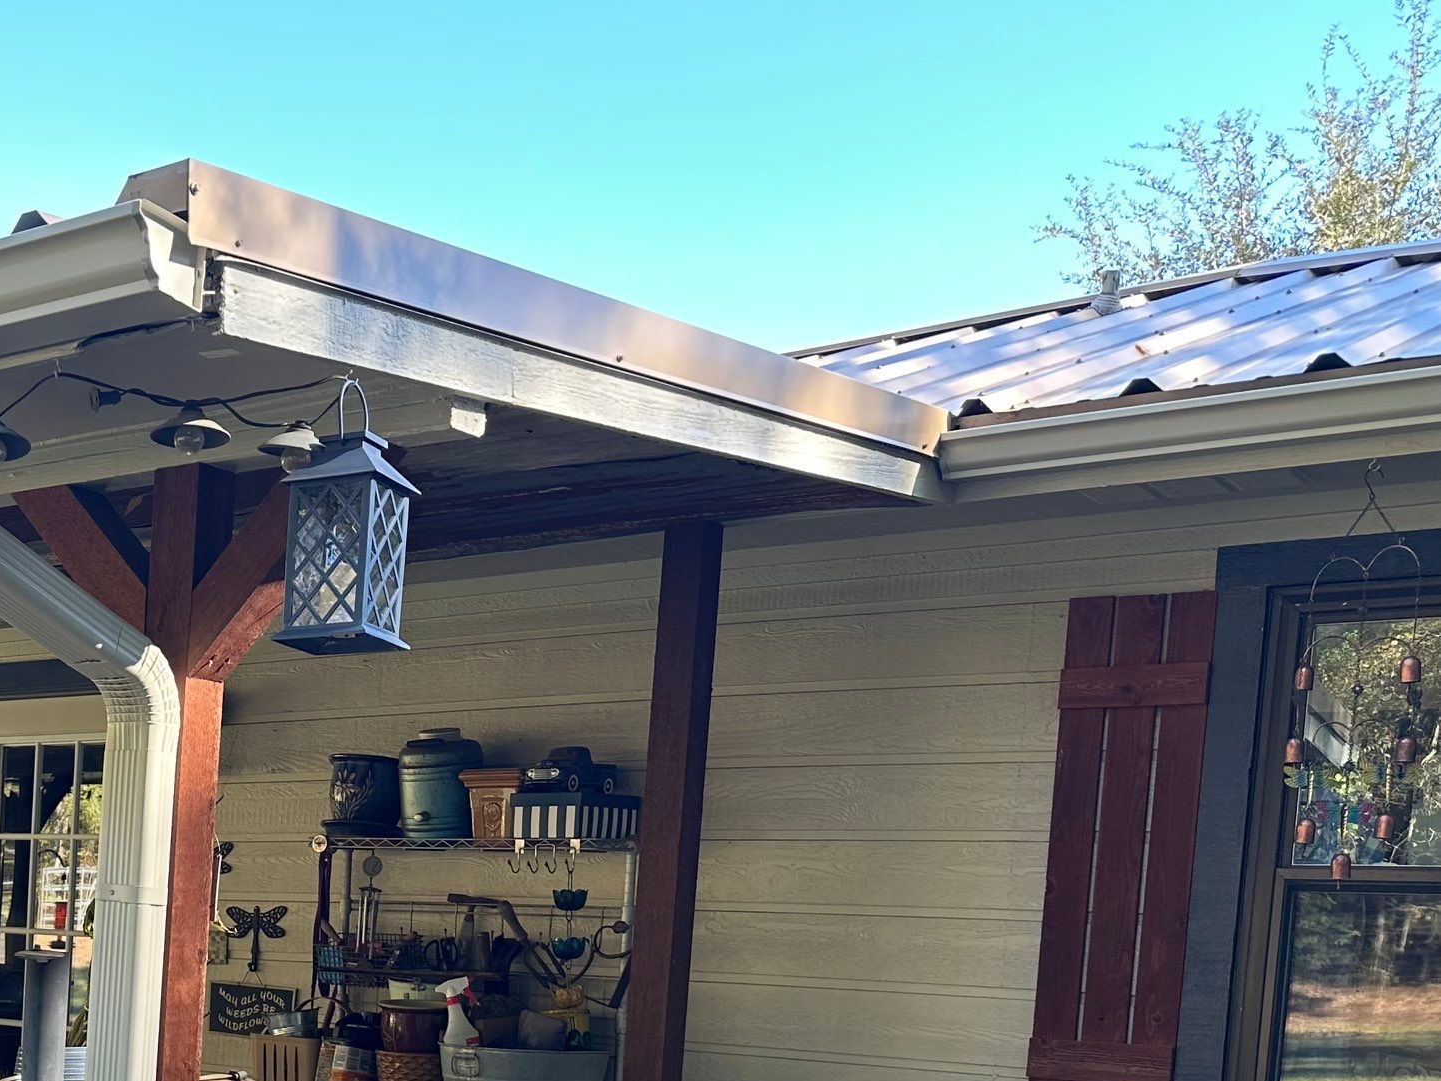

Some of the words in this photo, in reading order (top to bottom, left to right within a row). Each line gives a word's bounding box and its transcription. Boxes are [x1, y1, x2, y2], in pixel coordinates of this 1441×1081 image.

[219, 987, 238, 1008] MAY
[260, 990, 286, 1010] YOUR
[226, 1004, 260, 1019] WEEDS
[262, 1003, 276, 1014] BE
